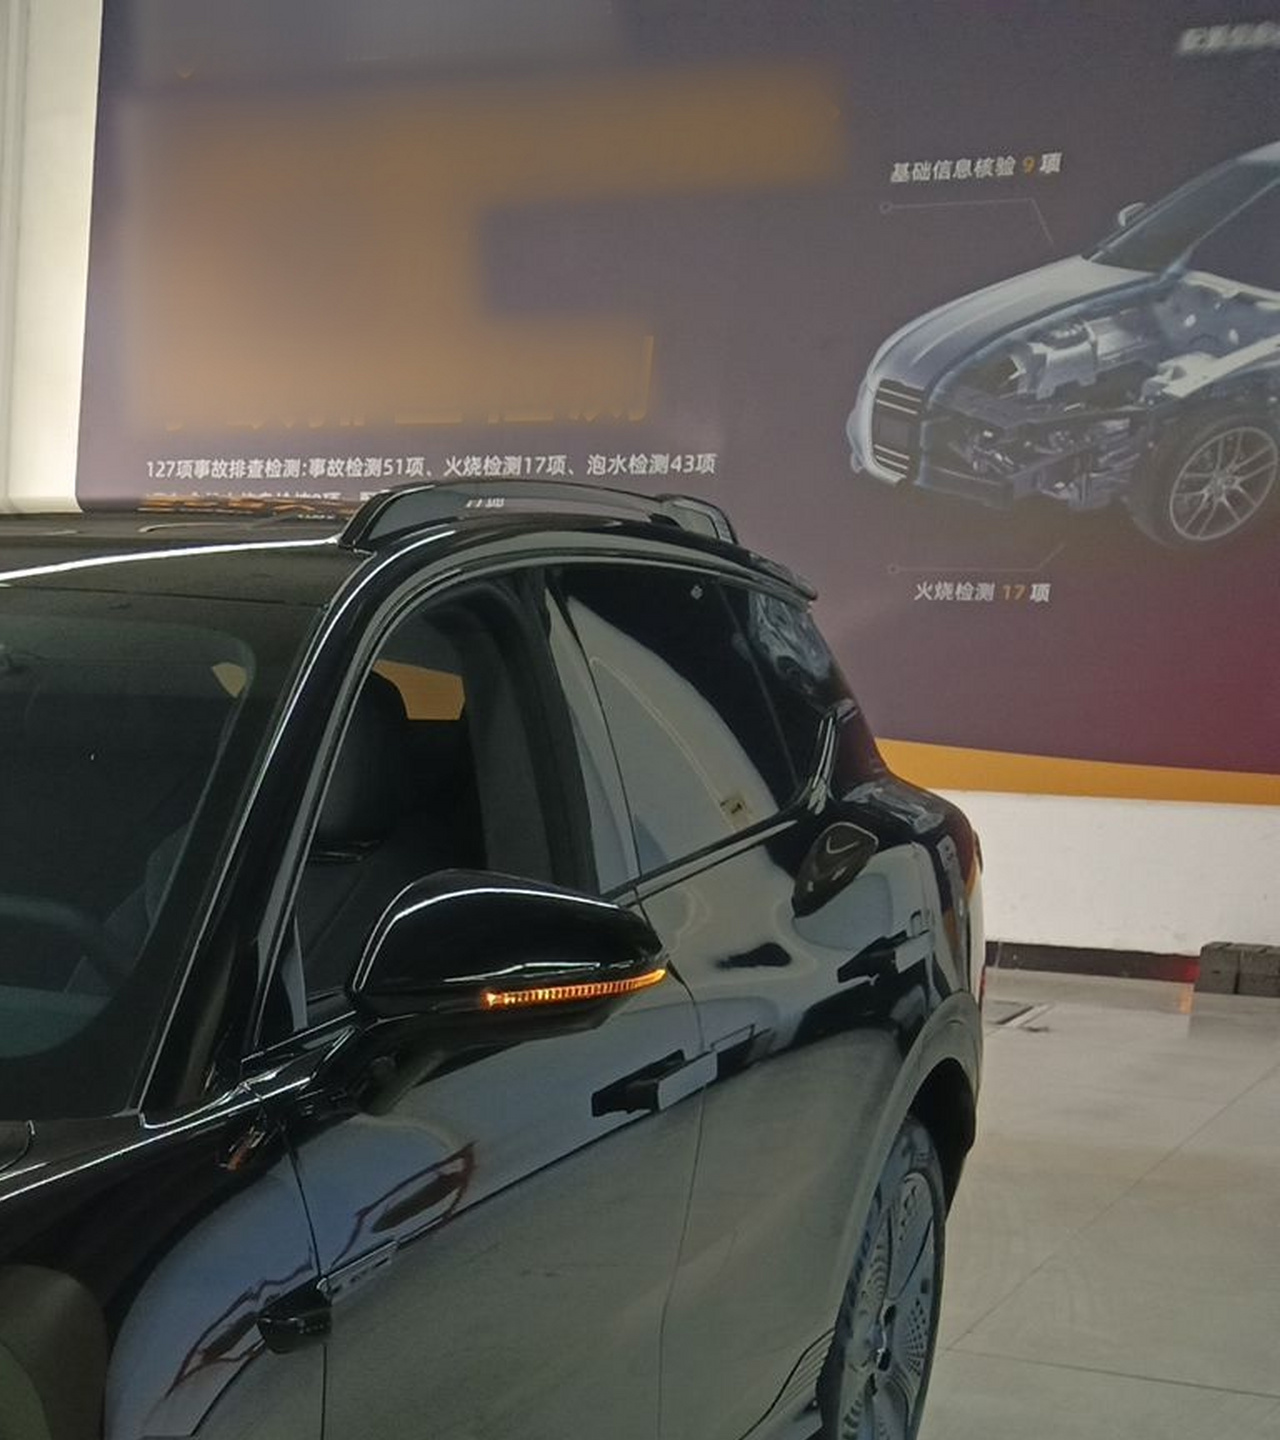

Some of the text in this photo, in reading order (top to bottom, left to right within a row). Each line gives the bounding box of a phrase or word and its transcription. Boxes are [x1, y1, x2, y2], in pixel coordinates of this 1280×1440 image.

[891, 156, 1016, 183] 基础信息核验
[914, 581, 996, 601] 火烧检测
